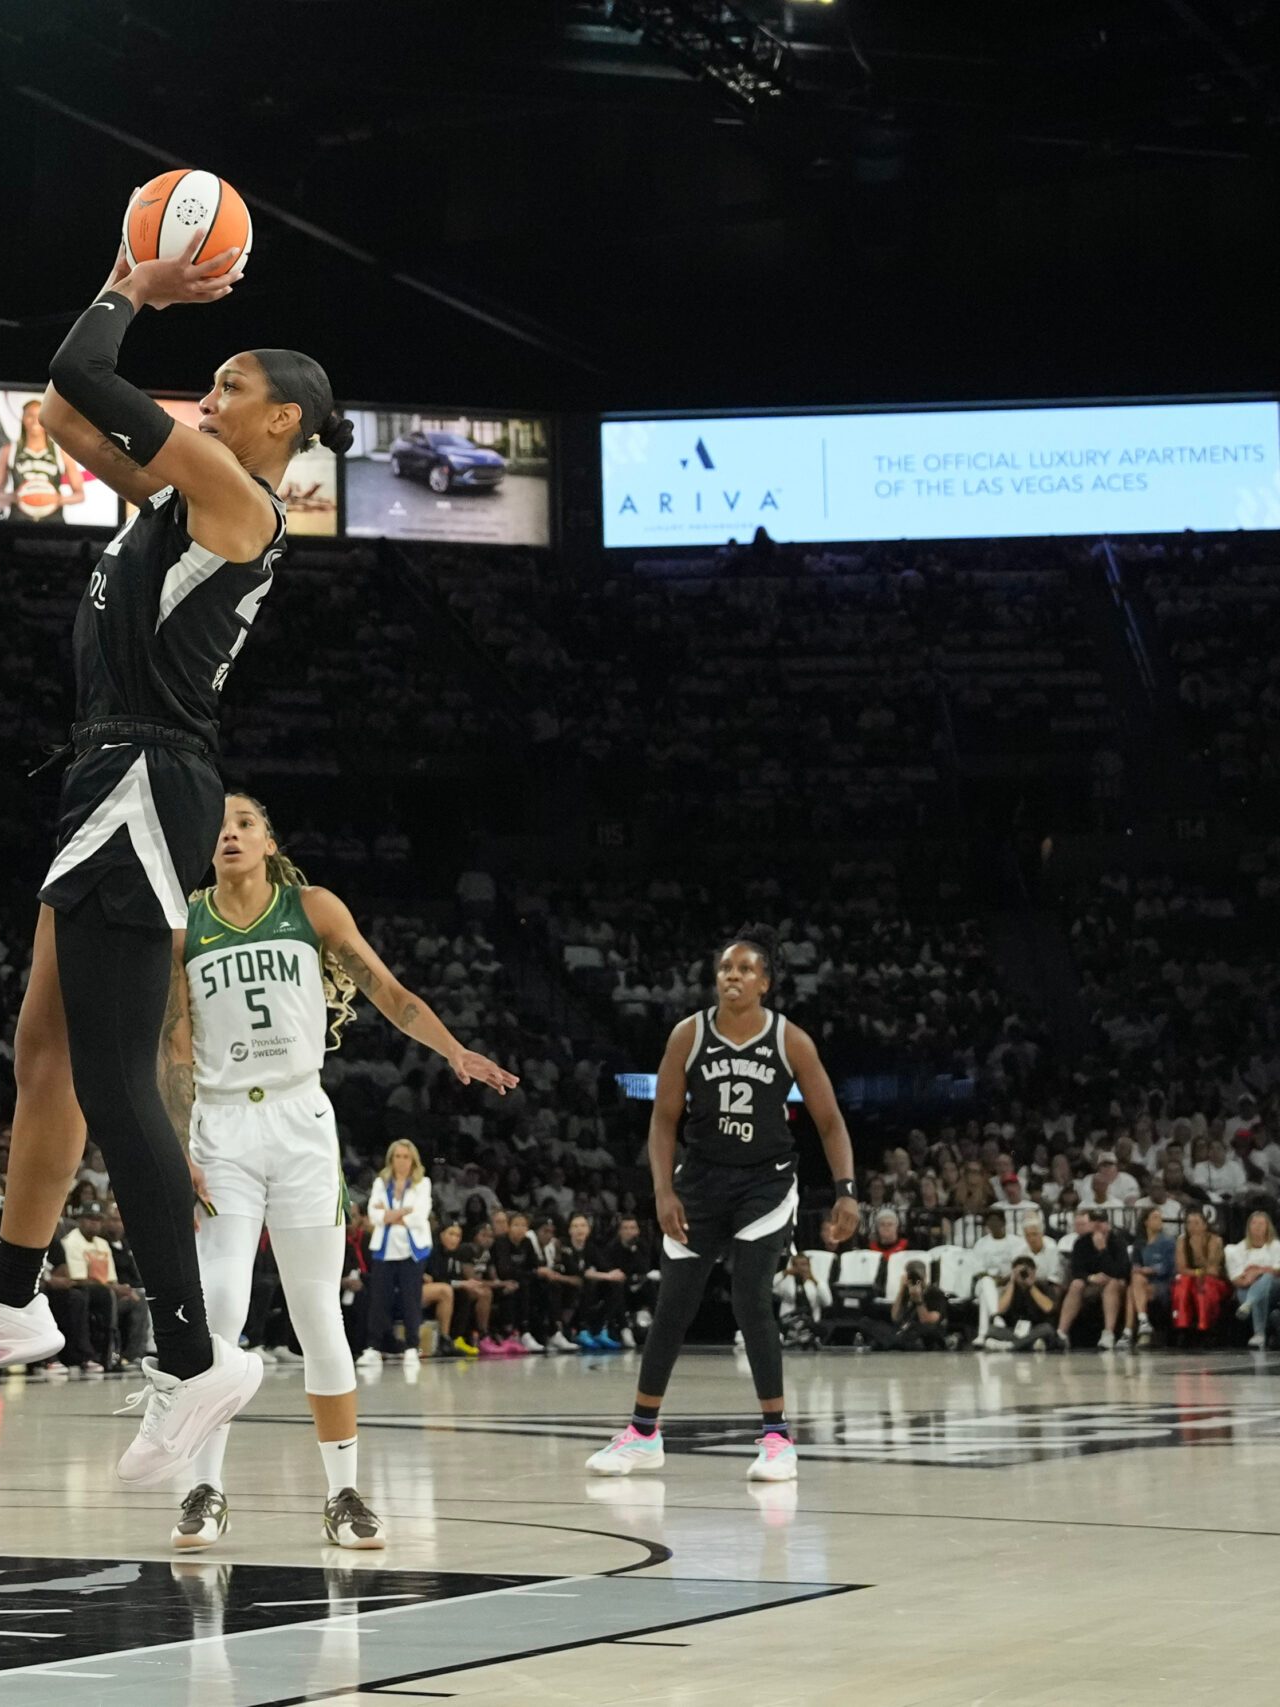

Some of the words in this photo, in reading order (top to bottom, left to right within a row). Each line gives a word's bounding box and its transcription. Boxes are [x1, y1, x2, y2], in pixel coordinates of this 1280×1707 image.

[874, 454, 916, 473] THE
[923, 451, 1023, 473] OFFICIAL
[1029, 449, 1111, 470] LUXURY
[1119, 444, 1266, 466] APARTMENTS
[874, 480, 906, 499] OF
[914, 478, 956, 497] THE
[963, 476, 1004, 496] LAS
[1010, 474, 1084, 495] VEGAS
[1091, 472, 1149, 493] ACES
[618, 489, 780, 515] ARIVA
[200, 949, 302, 1000] STORM
[244, 988, 272, 1030] 5
[251, 1035, 297, 1048] Providence
[252, 1048, 288, 1059] SWEDISH
[701, 1059, 731, 1081] LAS
[730, 1058, 776, 1085] VEGAS
[718, 1081, 754, 1114] 12
[718, 1116, 754, 1142] ring
